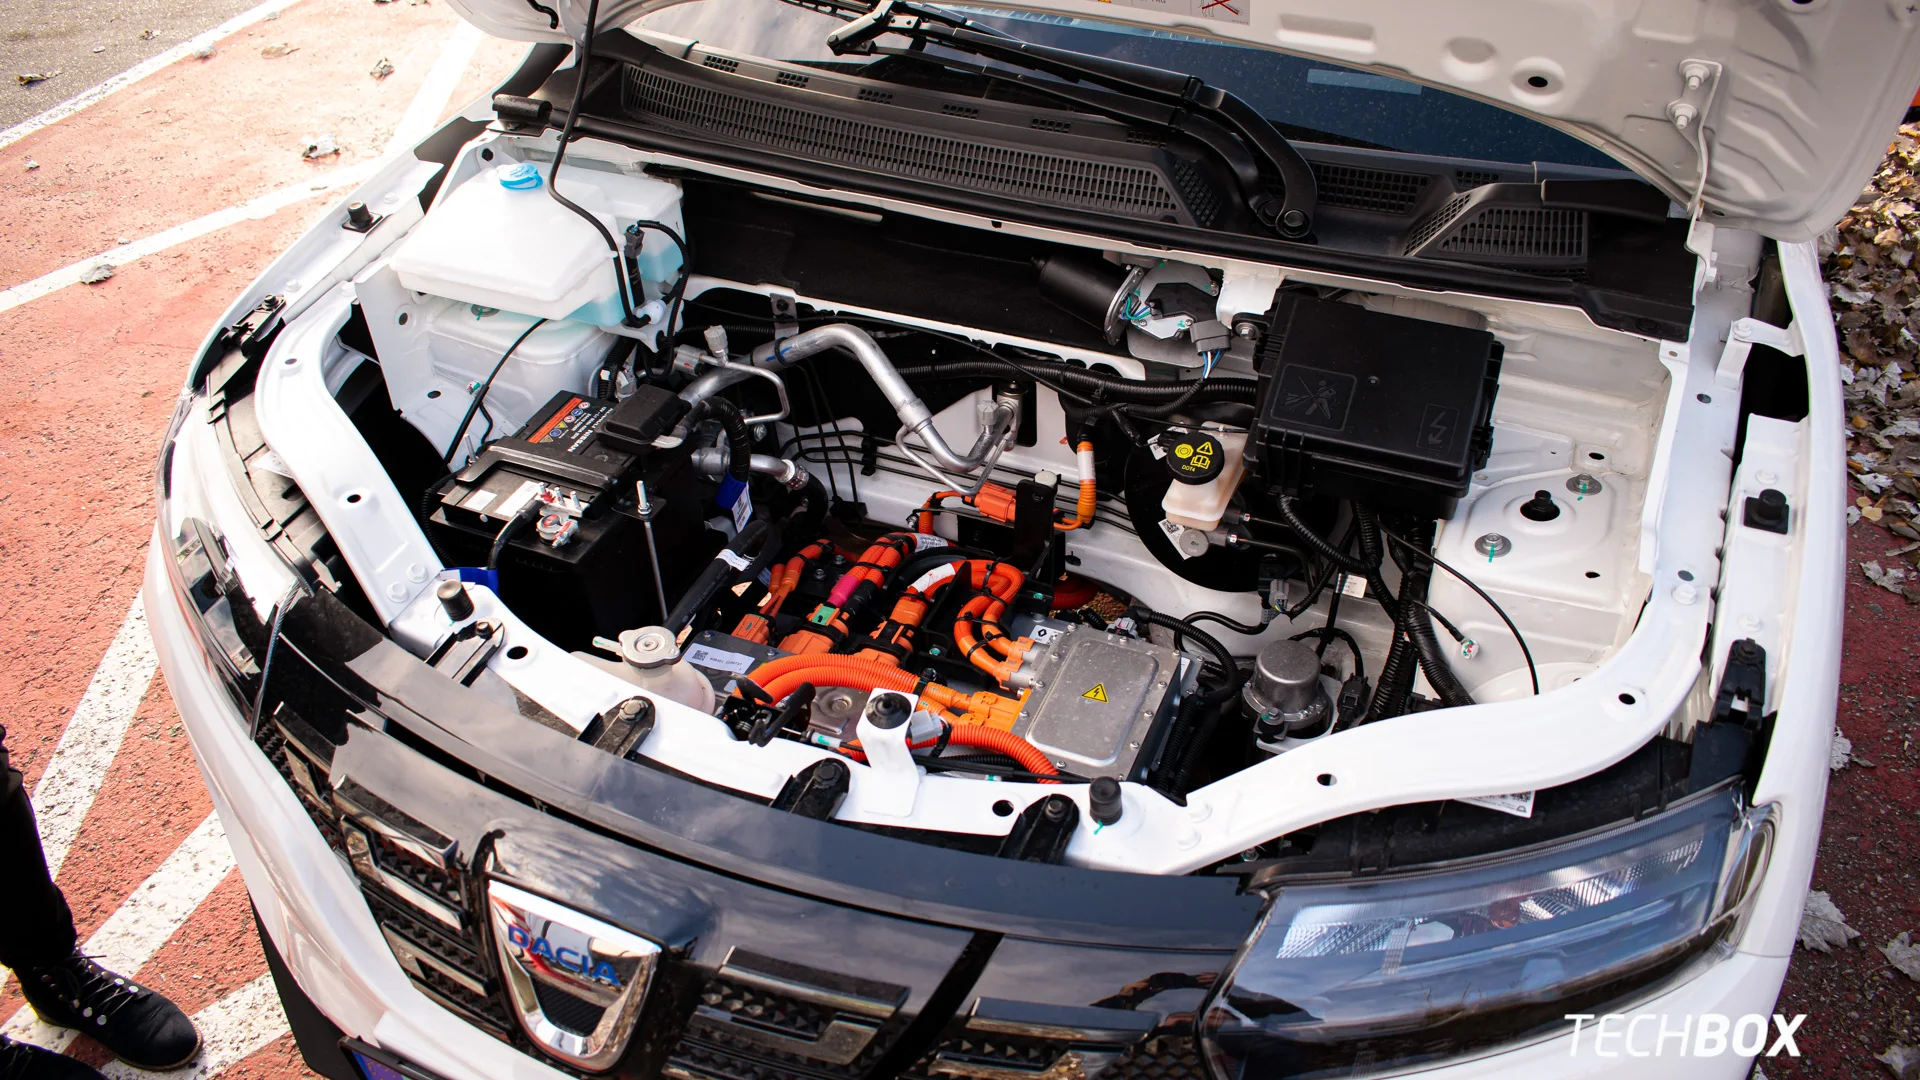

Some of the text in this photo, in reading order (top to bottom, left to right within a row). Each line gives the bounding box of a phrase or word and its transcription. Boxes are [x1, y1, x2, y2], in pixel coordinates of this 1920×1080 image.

[567, 430, 593, 452] NISSAN
[1181, 464, 1196, 473] DOT4
[508, 923, 621, 986] DACIA
